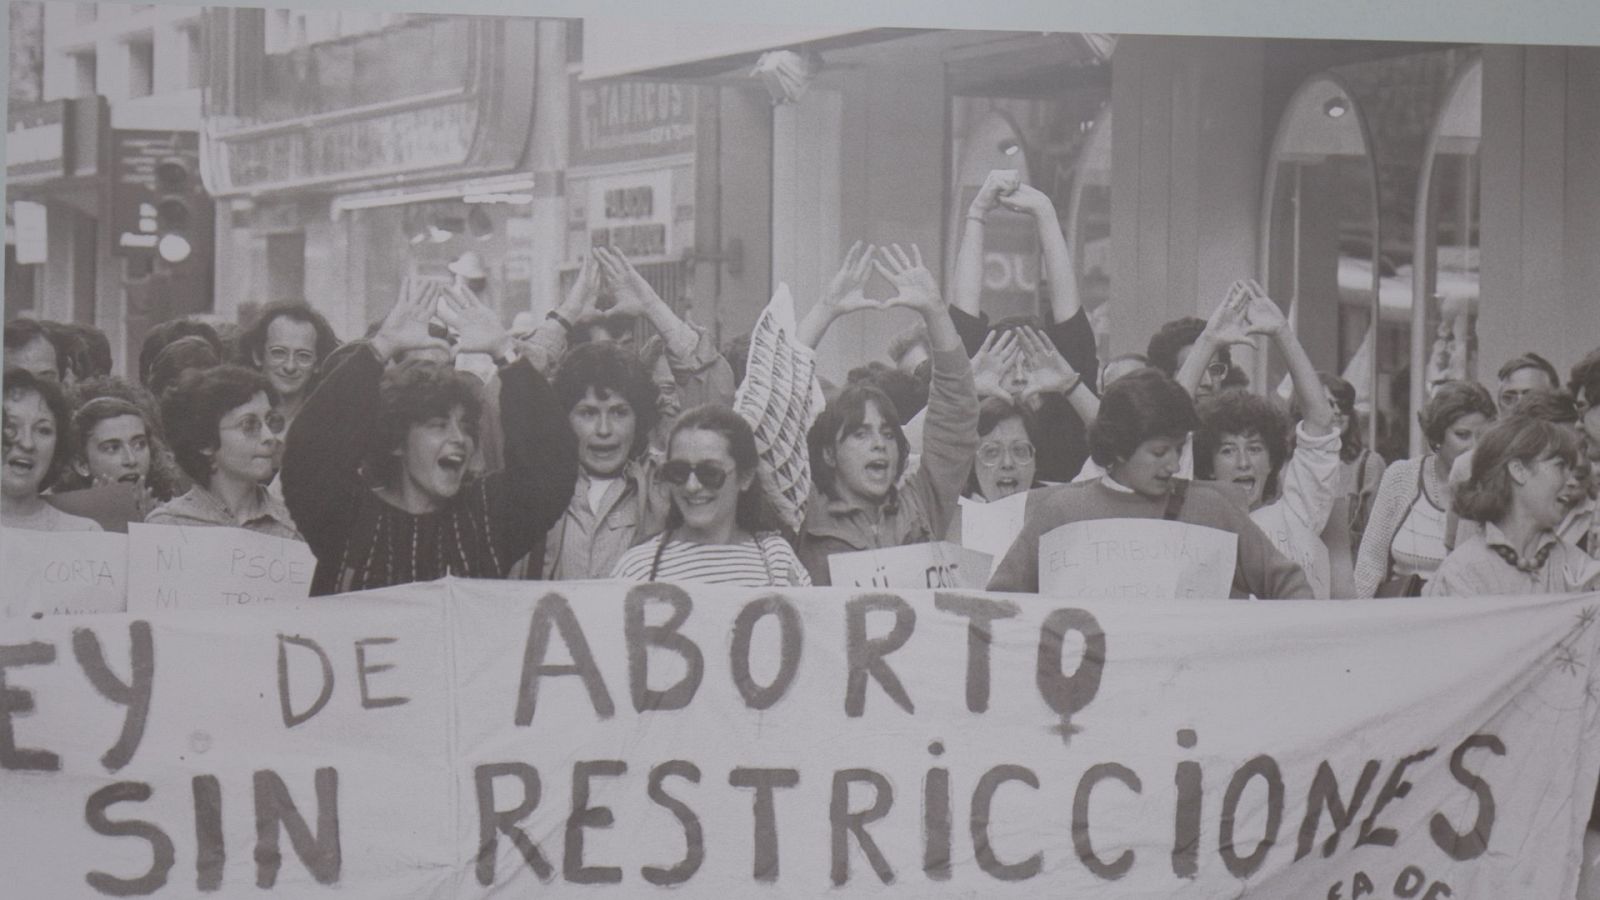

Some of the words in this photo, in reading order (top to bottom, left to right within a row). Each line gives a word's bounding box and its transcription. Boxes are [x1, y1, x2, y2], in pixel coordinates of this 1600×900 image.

[43, 559, 117, 587] CORTA
[231, 548, 309, 585] PSOE
[276, 632, 411, 728] DE
[513, 583, 1107, 748] ABORTO
[84, 765, 343, 896] SIN
